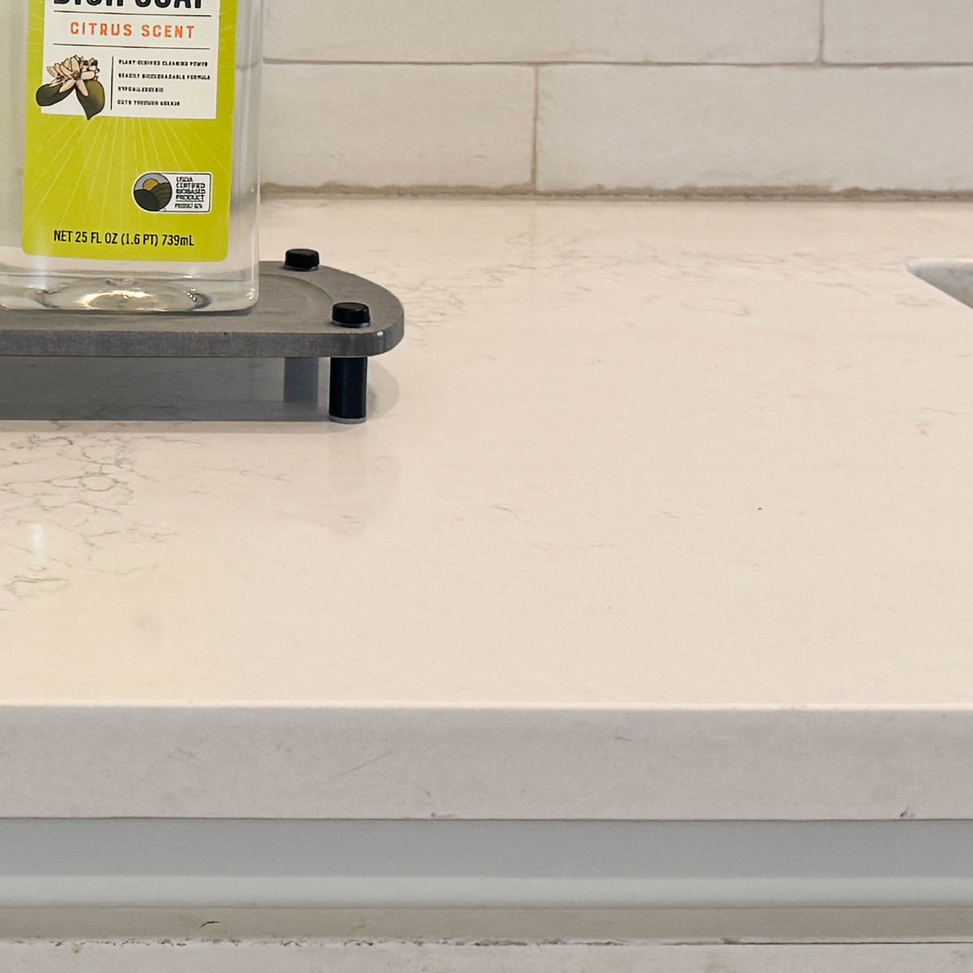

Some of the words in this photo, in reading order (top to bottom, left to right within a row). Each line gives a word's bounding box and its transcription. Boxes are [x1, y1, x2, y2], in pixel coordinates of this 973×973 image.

[70, 21, 133, 37] CITRUS
[141, 24, 195, 39] SCENT
[53, 230, 73, 242] NET
[75, 231, 88, 243] 25
[90, 232, 101, 244] FL
[104, 232, 118, 244] OZ
[121, 233, 140, 246] (1.6
[143, 234, 159, 246] PT)
[162, 234, 194, 246] 739mL
